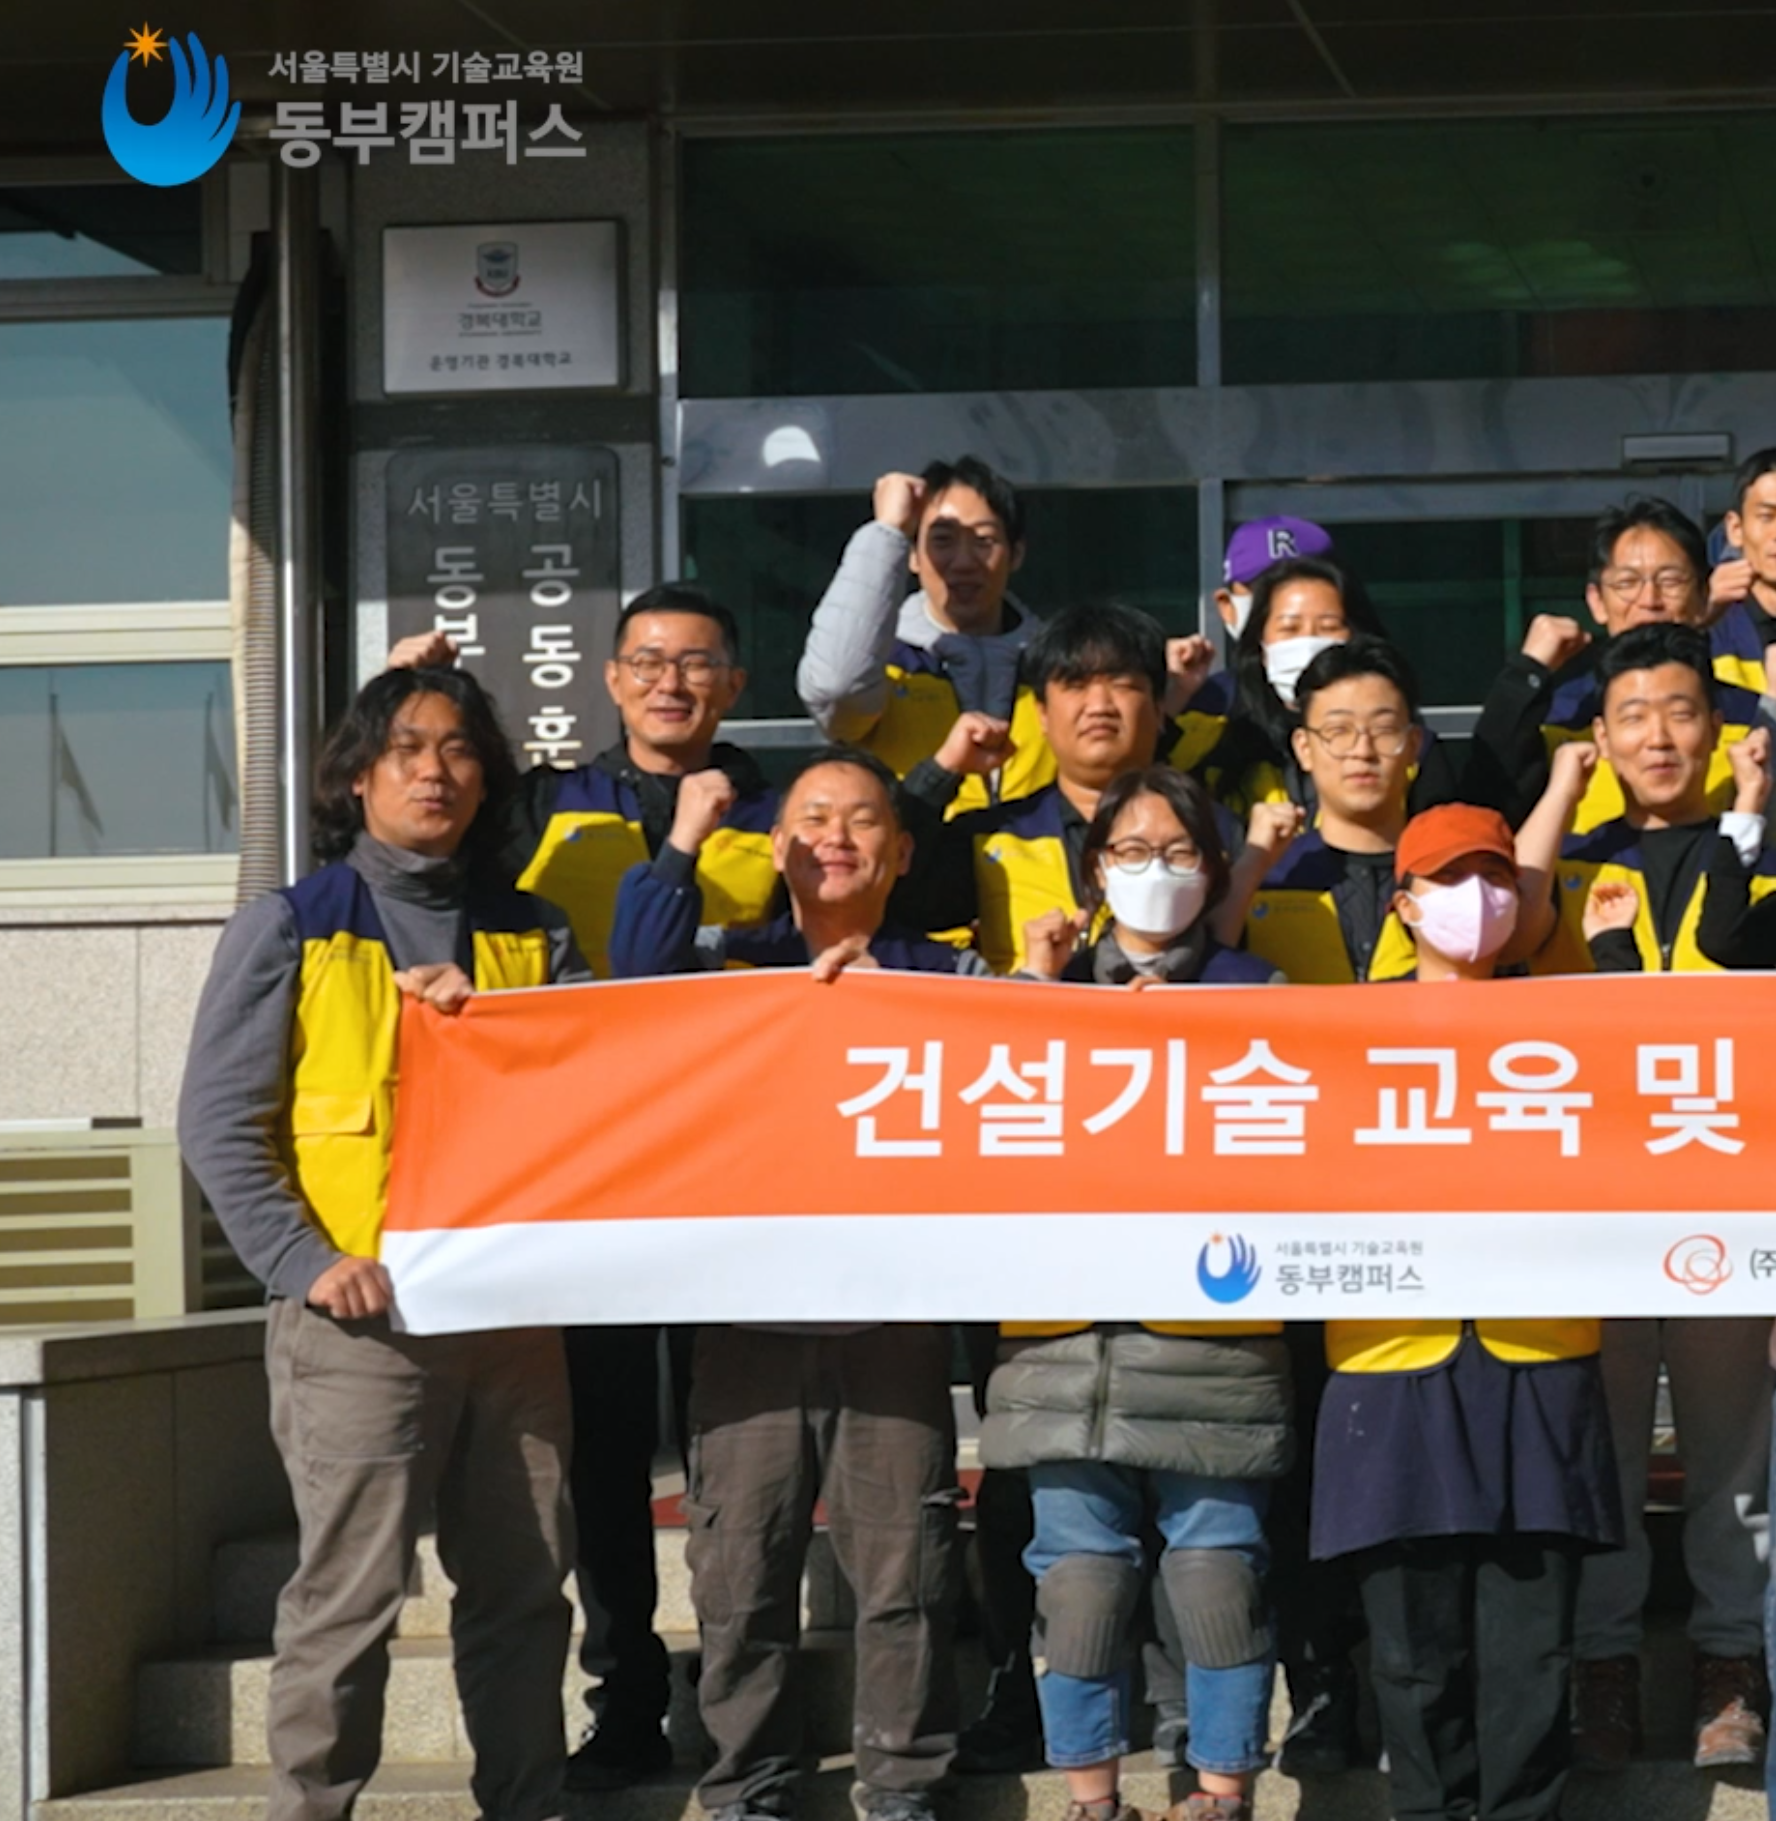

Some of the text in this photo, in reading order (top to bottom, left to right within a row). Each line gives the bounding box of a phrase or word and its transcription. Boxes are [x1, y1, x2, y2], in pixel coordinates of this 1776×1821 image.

[458, 311, 542, 330] 경복대학교
[496, 352, 573, 370] 경복대학교
[408, 481, 602, 524] 서울특별시
[837, 1039, 1321, 1158] 건설기술
[1354, 1041, 1594, 1158] 교육
[1637, 1038, 1746, 1156] 및
[1276, 1241, 1424, 1257] 서울특별시 기술교육원
[1276, 1264, 1425, 1296] 동부캠퍼스
